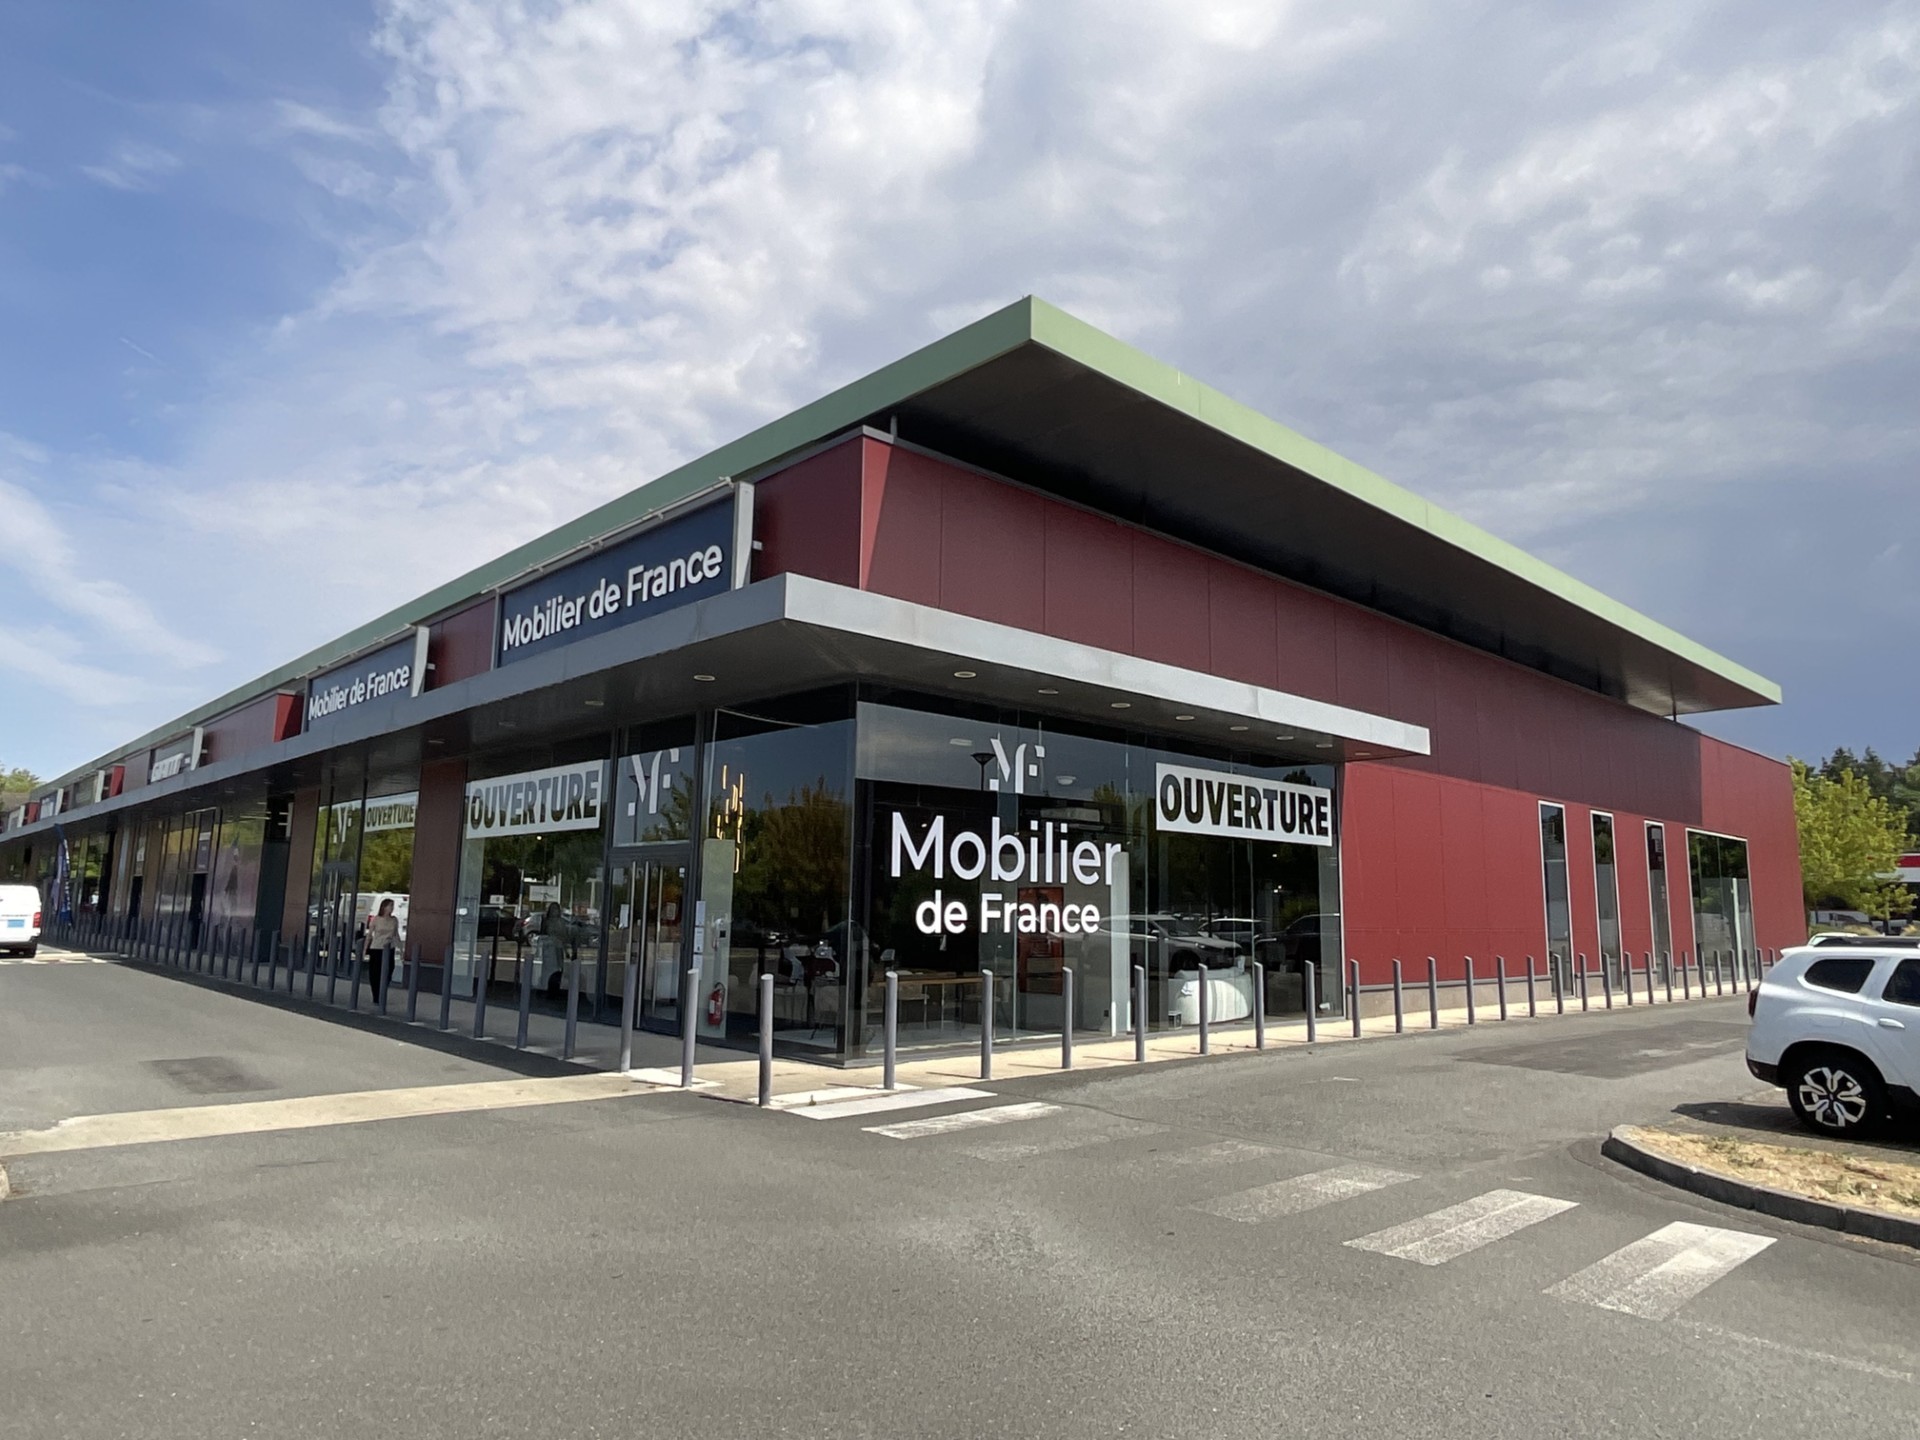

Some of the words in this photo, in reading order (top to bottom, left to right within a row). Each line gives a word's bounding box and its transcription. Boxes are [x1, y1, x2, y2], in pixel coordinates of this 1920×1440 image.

[503, 593, 587, 651] Mobilier
[588, 577, 621, 620] de
[626, 543, 724, 608] France
[308, 683, 350, 722] Mobilier
[350, 677, 366, 705] de
[366, 663, 410, 701] France
[365, 802, 415, 829] OUVERTURE
[470, 769, 599, 830] OUVERTURE
[1159, 773, 1329, 837] OUVERTURE
[890, 810, 1122, 887] Mobilier
[915, 888, 968, 935] de
[980, 892, 1100, 935] France
